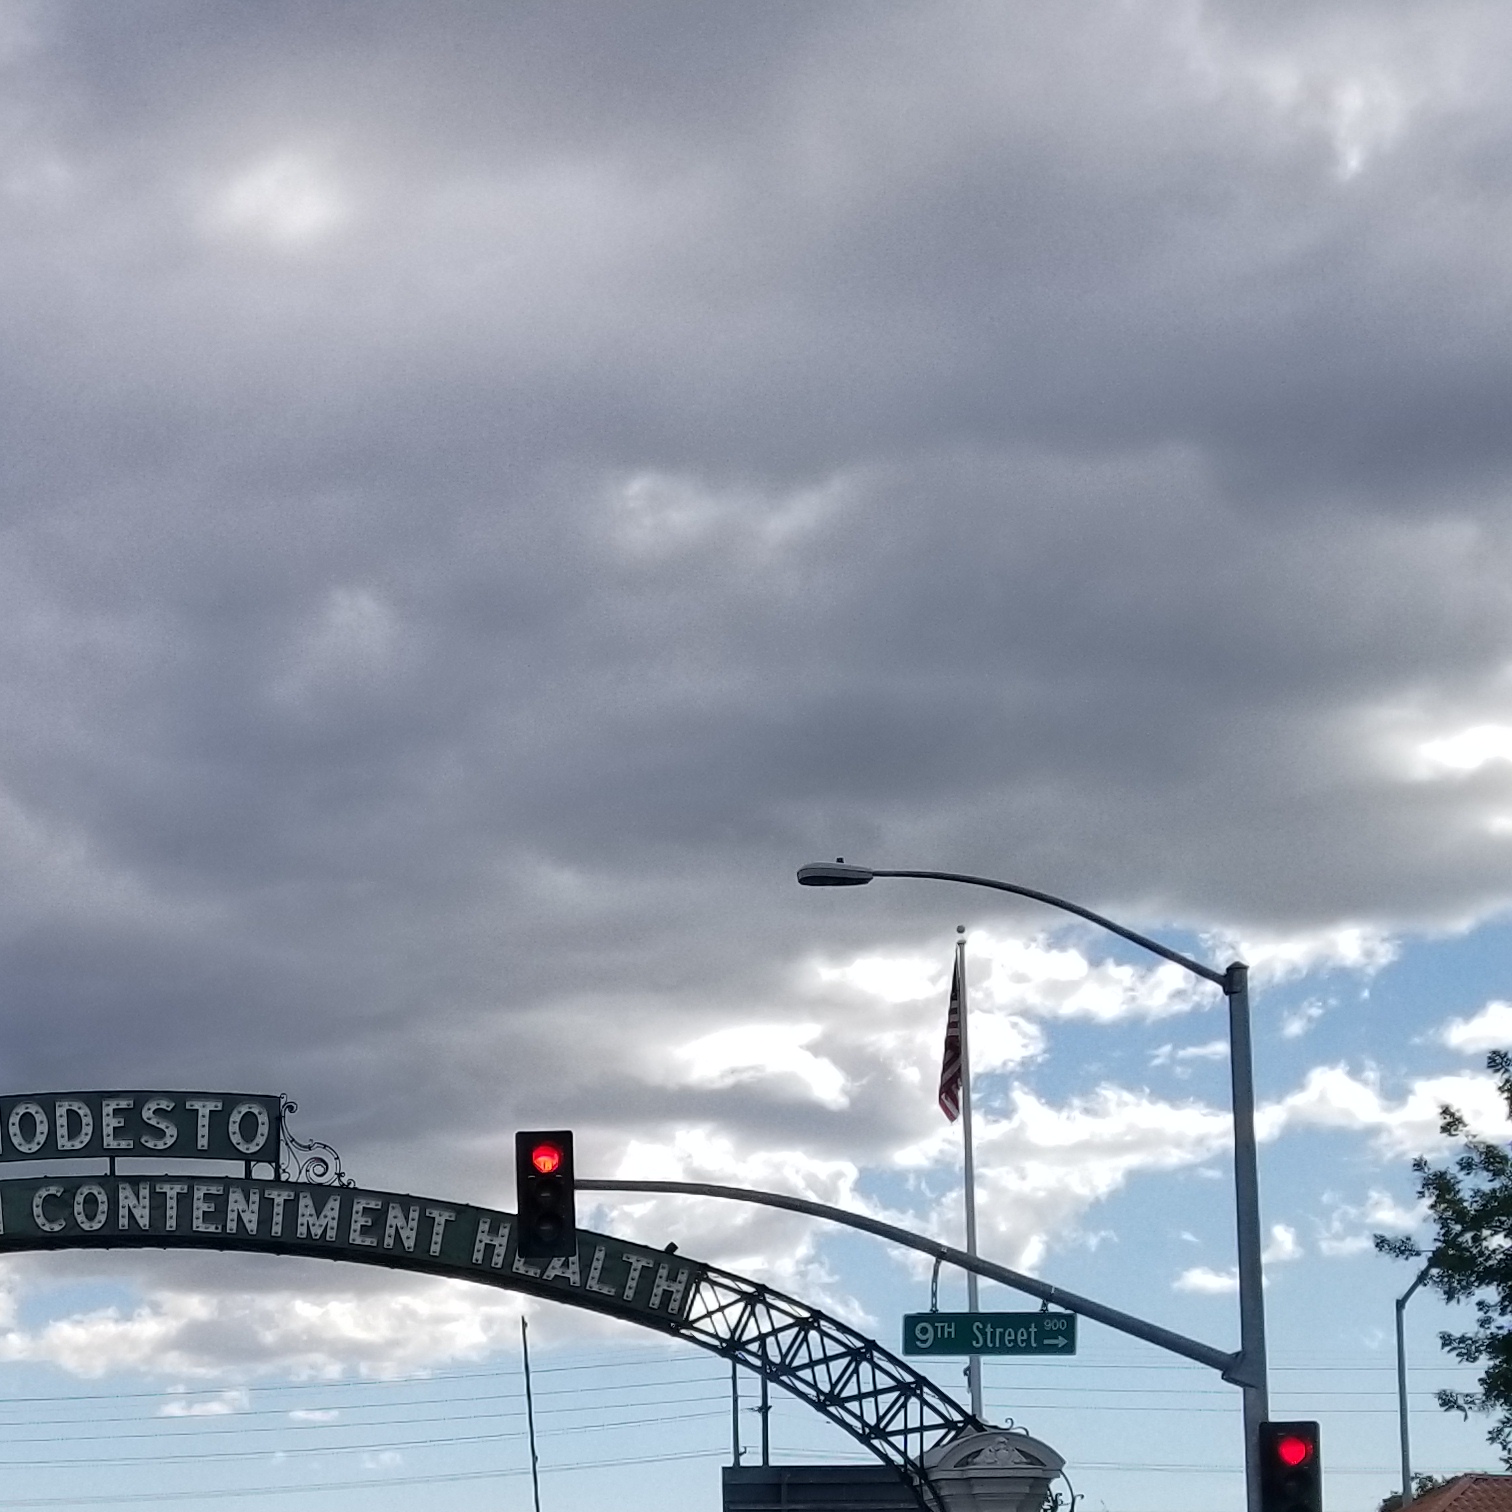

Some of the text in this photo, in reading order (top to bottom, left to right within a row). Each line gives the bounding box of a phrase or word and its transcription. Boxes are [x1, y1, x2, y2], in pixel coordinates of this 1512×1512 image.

[33, 1183, 455, 1256] CONTENTMENT
[472, 1218, 688, 1314] HALTH
[915, 1320, 1067, 1348] 9TH Street 900
